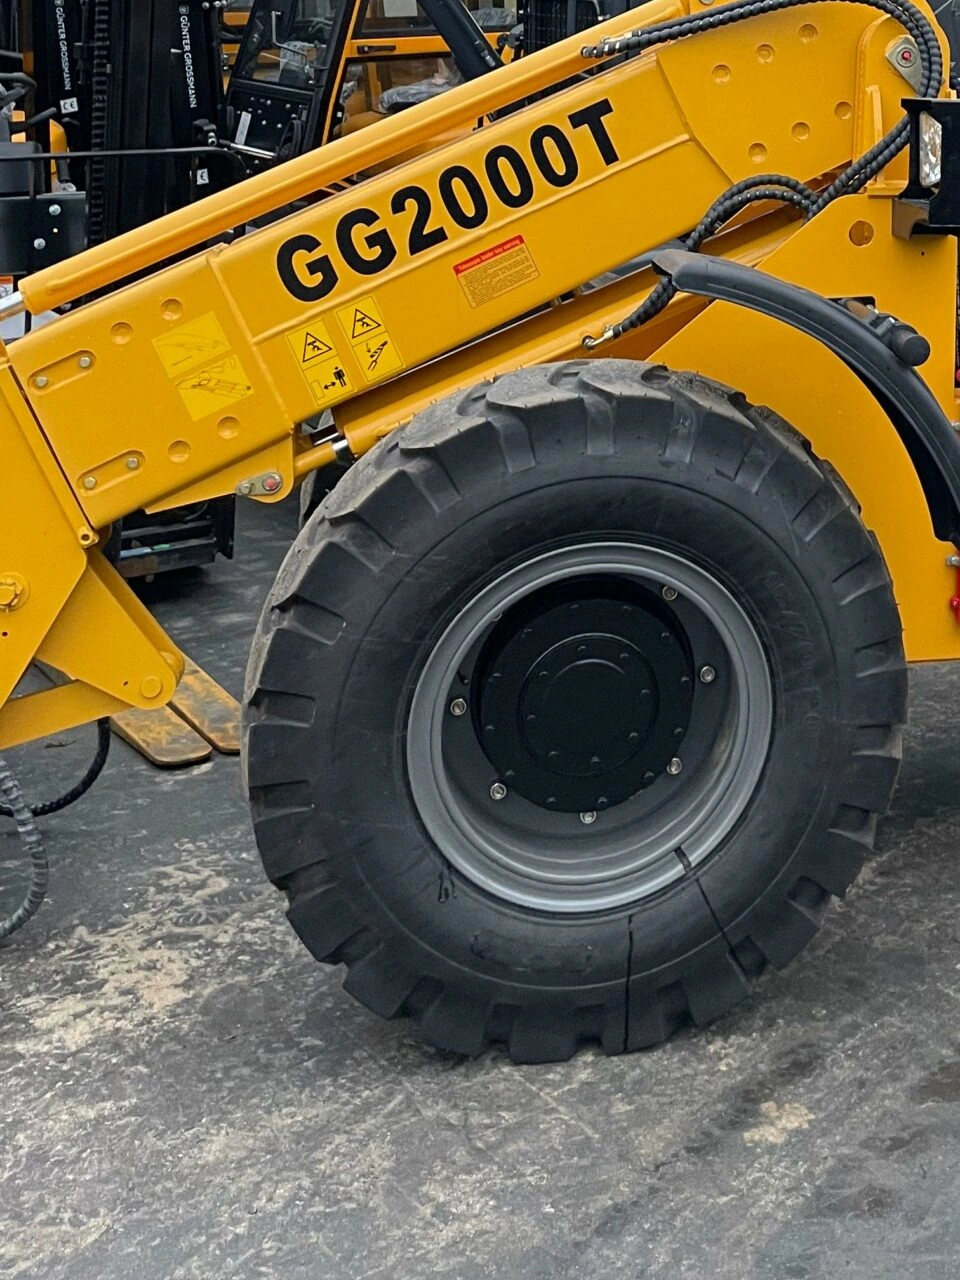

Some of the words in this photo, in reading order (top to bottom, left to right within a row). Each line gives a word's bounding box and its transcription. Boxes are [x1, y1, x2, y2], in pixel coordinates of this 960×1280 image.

[56, 7, 67, 40] GÜNTER
[180, 15, 191, 51] GÜNTER
[59, 40, 71, 90] GROSSMANN
[184, 52, 197, 108] GROSSMANN
[276, 98, 620, 302] GG2000T
